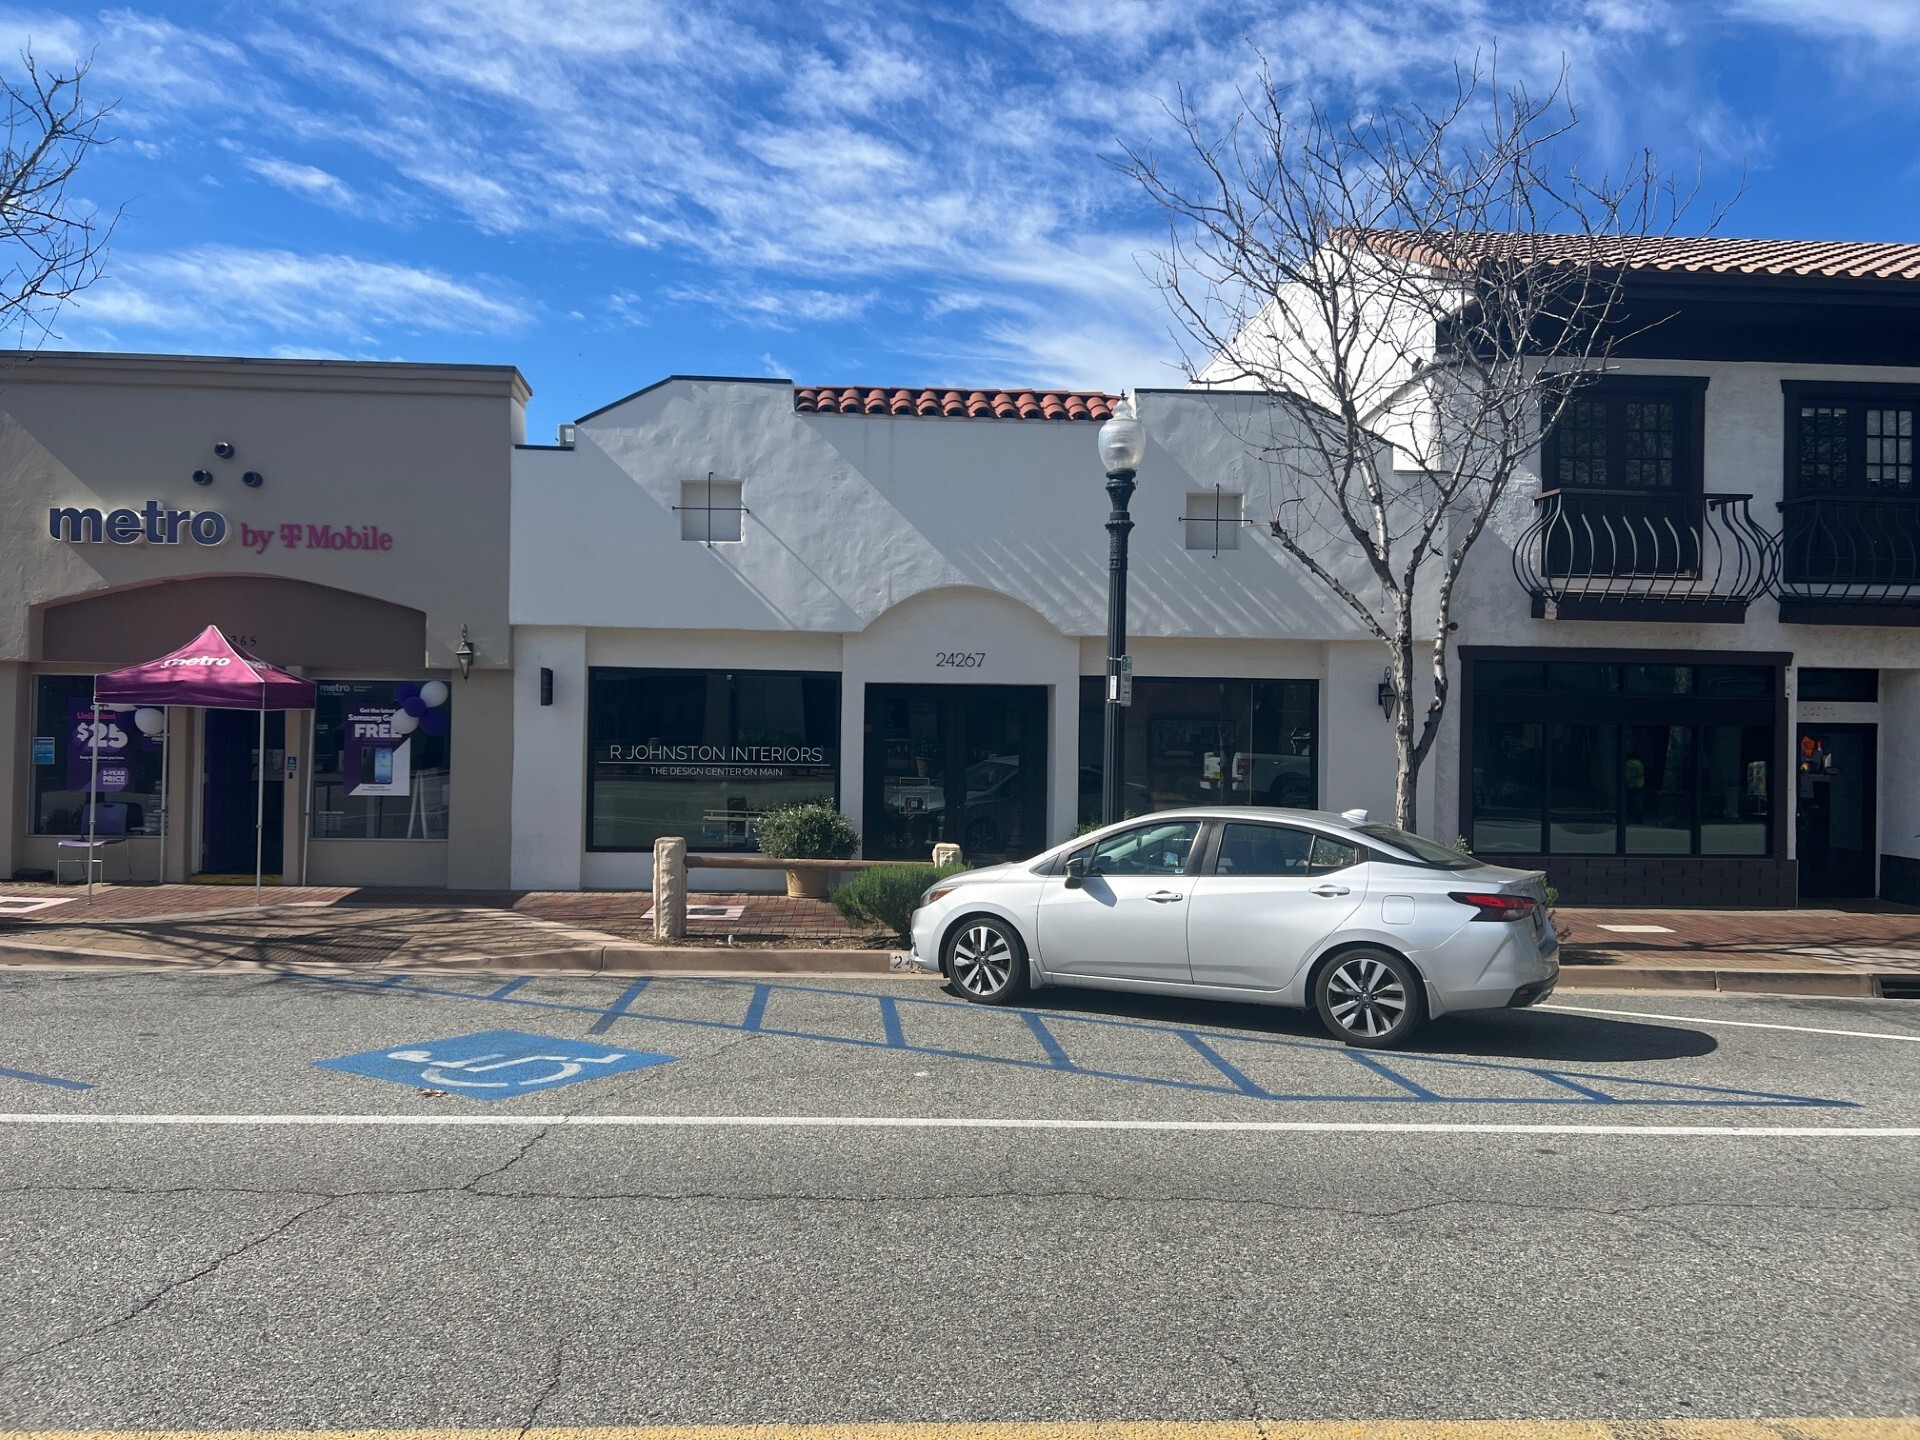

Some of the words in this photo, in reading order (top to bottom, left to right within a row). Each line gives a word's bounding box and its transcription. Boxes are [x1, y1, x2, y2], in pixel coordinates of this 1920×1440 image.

[49, 500, 228, 547] metro
[240, 522, 274, 554] by
[160, 655, 231, 669] metro
[936, 652, 986, 668] 24267
[319, 683, 350, 692] metro
[77, 712, 116, 720] Unliited
[77, 722, 128, 748] $25
[610, 745, 622, 759] R
[626, 745, 725, 760] JOHNSTON
[731, 746, 823, 762] INTERIORS
[650, 767, 668, 775] THE
[669, 767, 704, 775] DESIGN
[705, 767, 742, 776] CENTER
[743, 768, 758, 776] ON
[759, 768, 783, 776] MAIN
